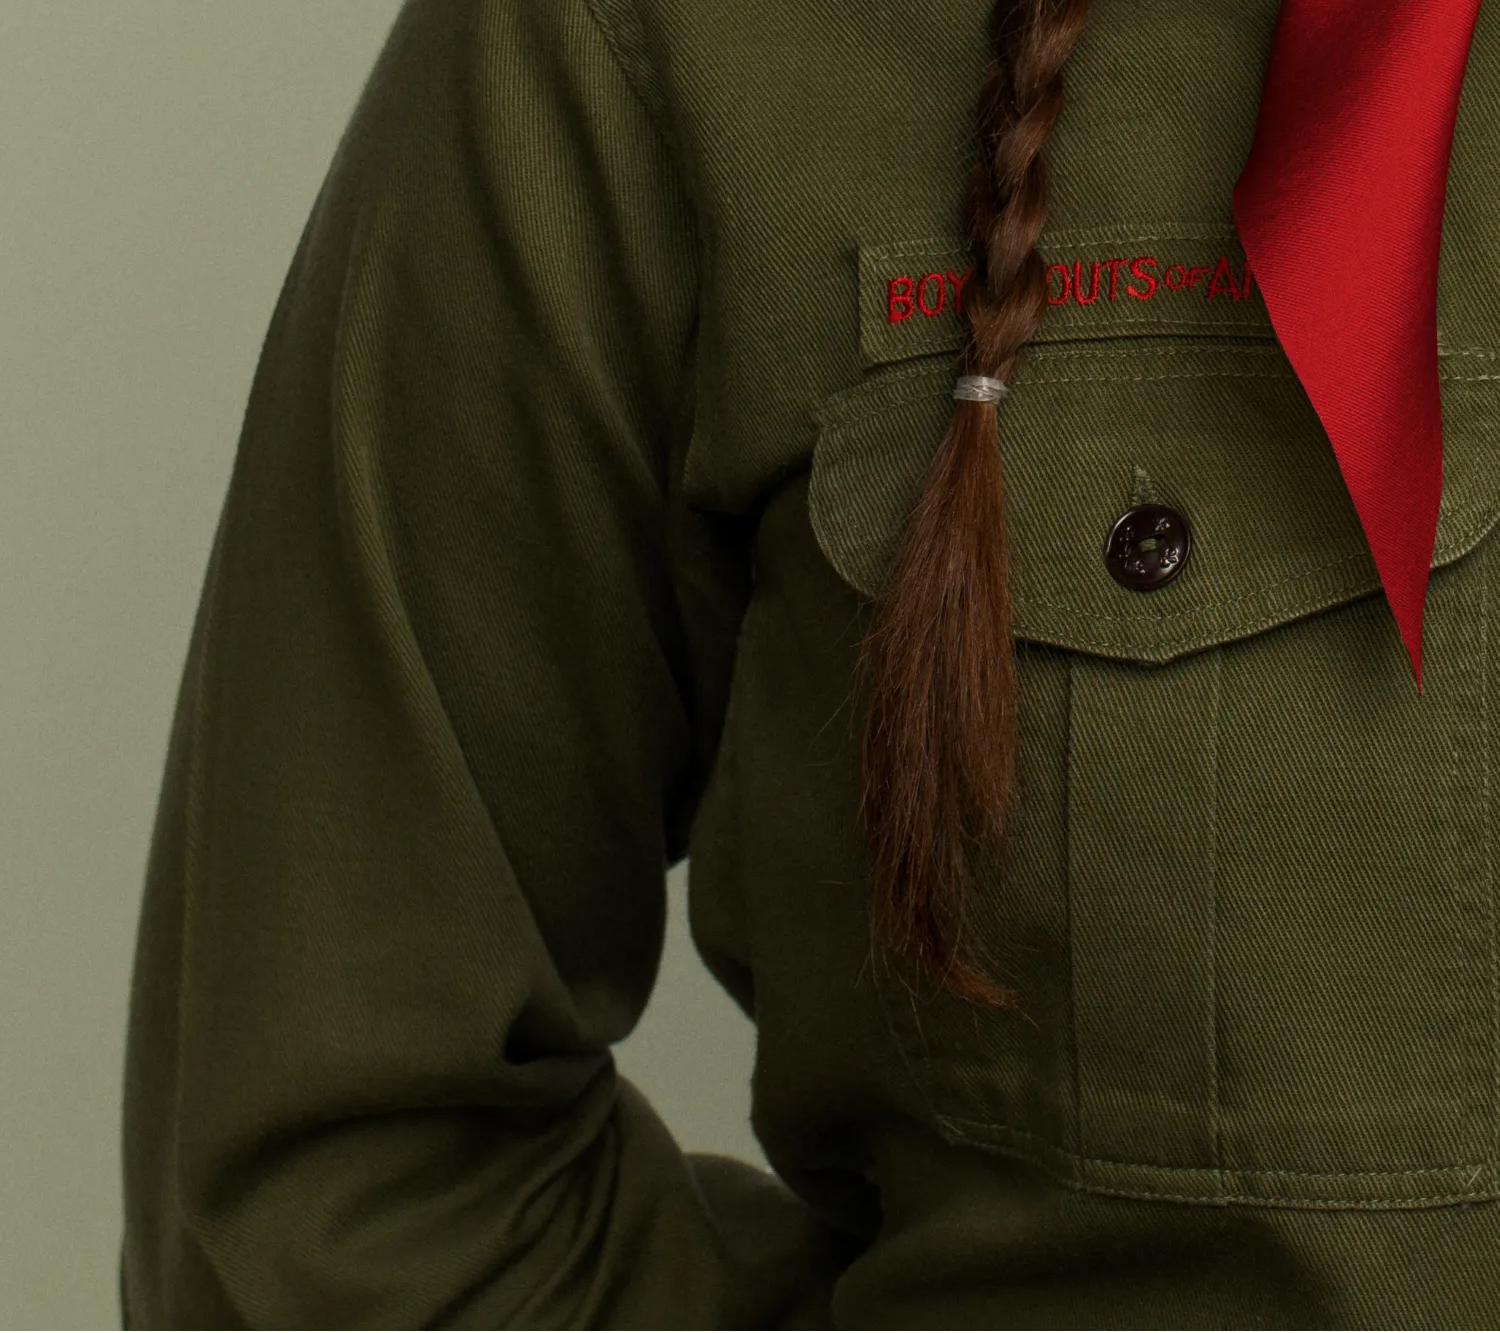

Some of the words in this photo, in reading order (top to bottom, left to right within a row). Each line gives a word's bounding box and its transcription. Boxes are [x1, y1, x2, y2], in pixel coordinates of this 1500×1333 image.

[888, 268, 975, 325] BOY
[1045, 257, 1158, 307] OUTS
[1164, 264, 1211, 290] OF
